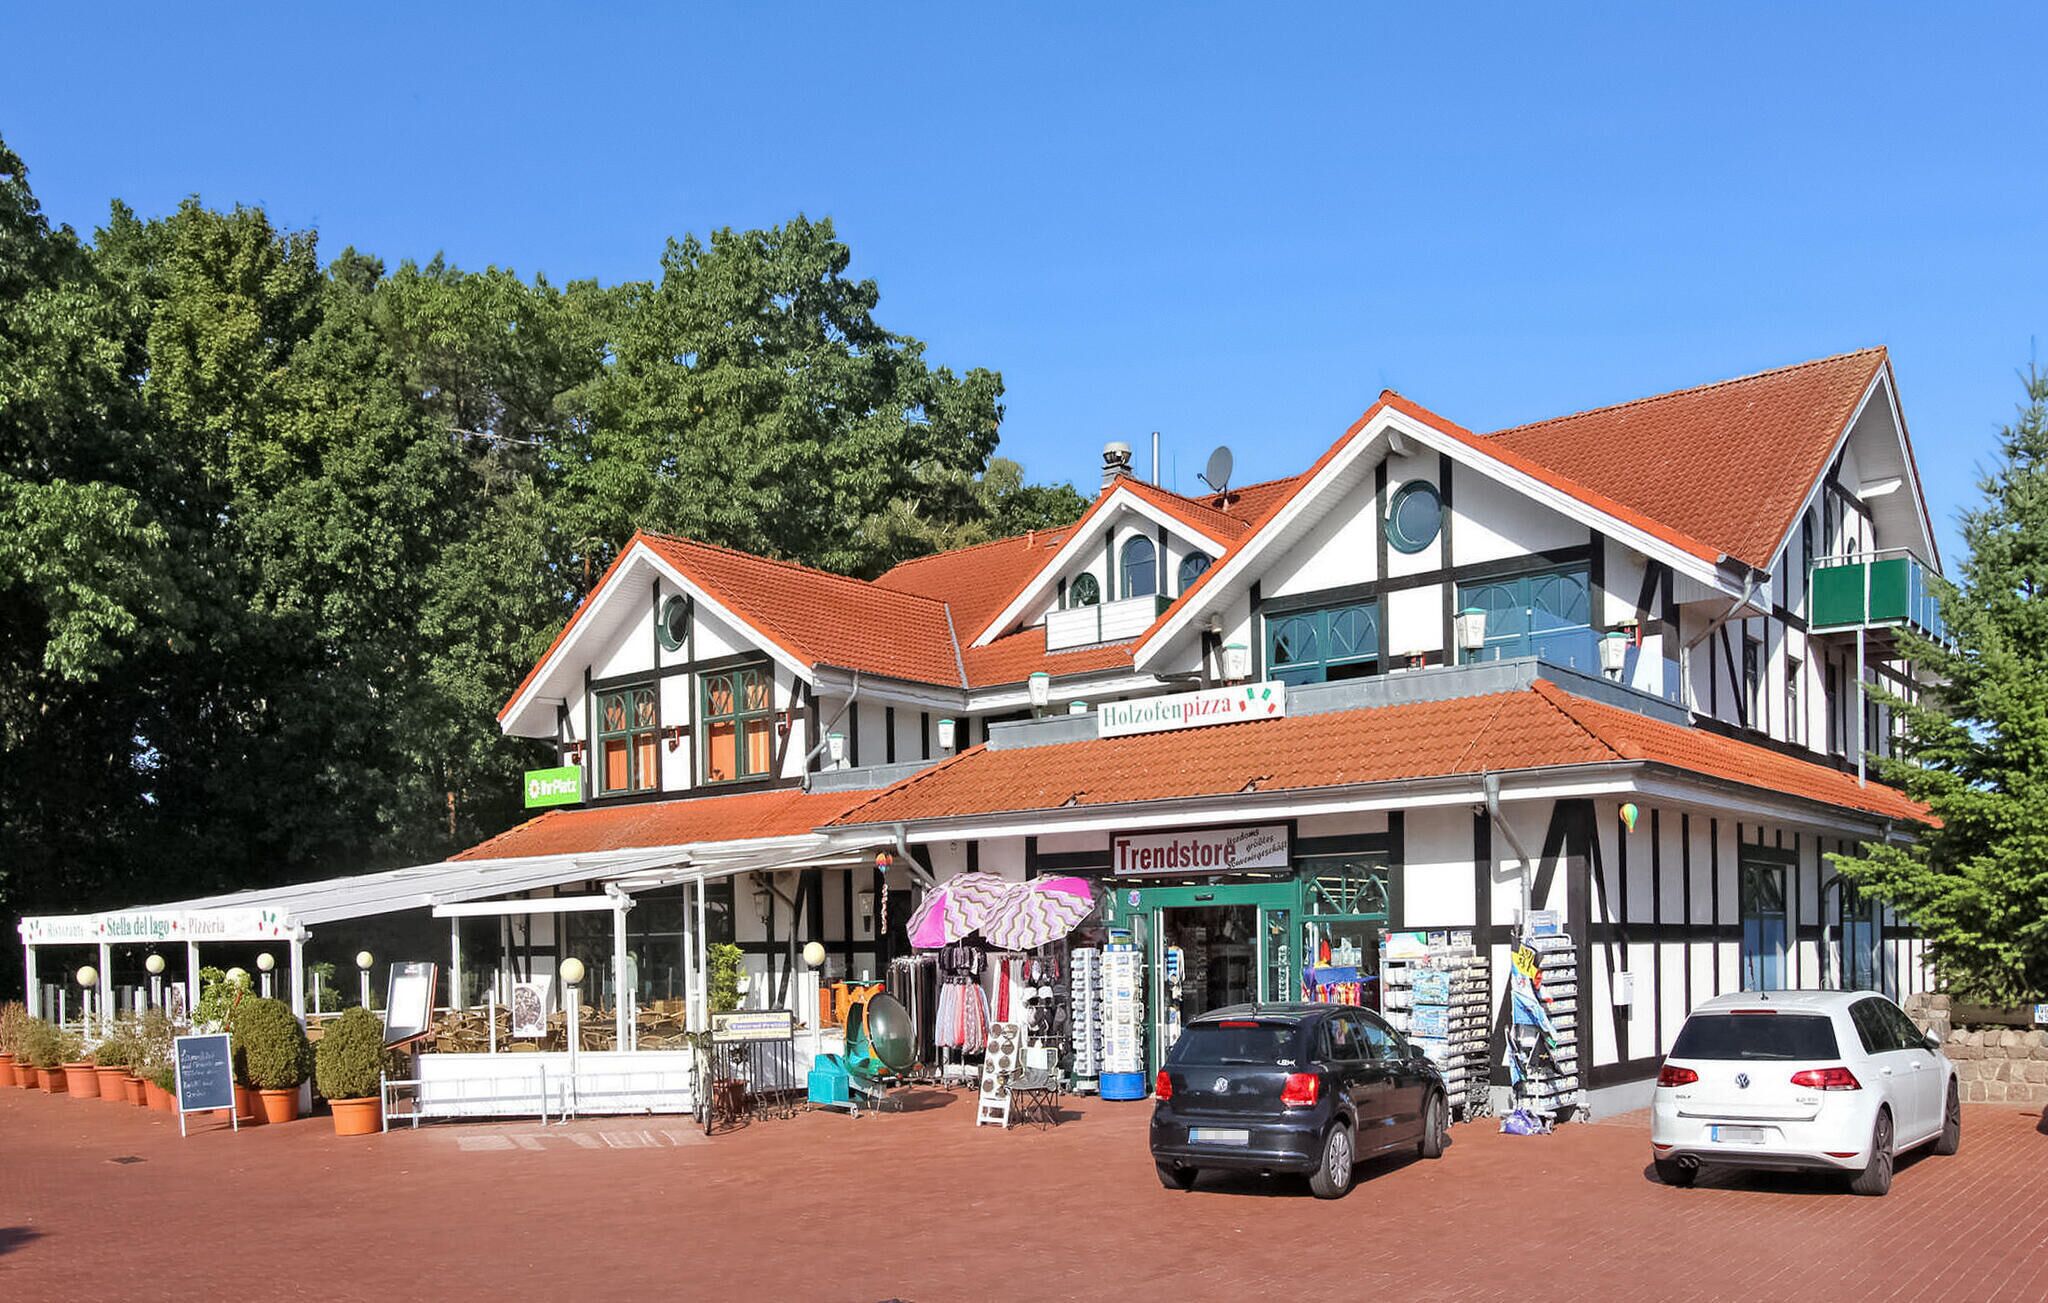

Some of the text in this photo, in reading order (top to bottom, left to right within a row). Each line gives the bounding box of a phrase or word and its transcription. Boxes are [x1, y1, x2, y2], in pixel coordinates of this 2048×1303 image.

[1103, 695, 1231, 727] Holzofenpizza
[1116, 839, 1237, 870] Trendstore
[106, 917, 133, 936] Stella
[133, 916, 148, 935] del
[149, 915, 170, 940] lago
[188, 916, 225, 934] Pizzeria
